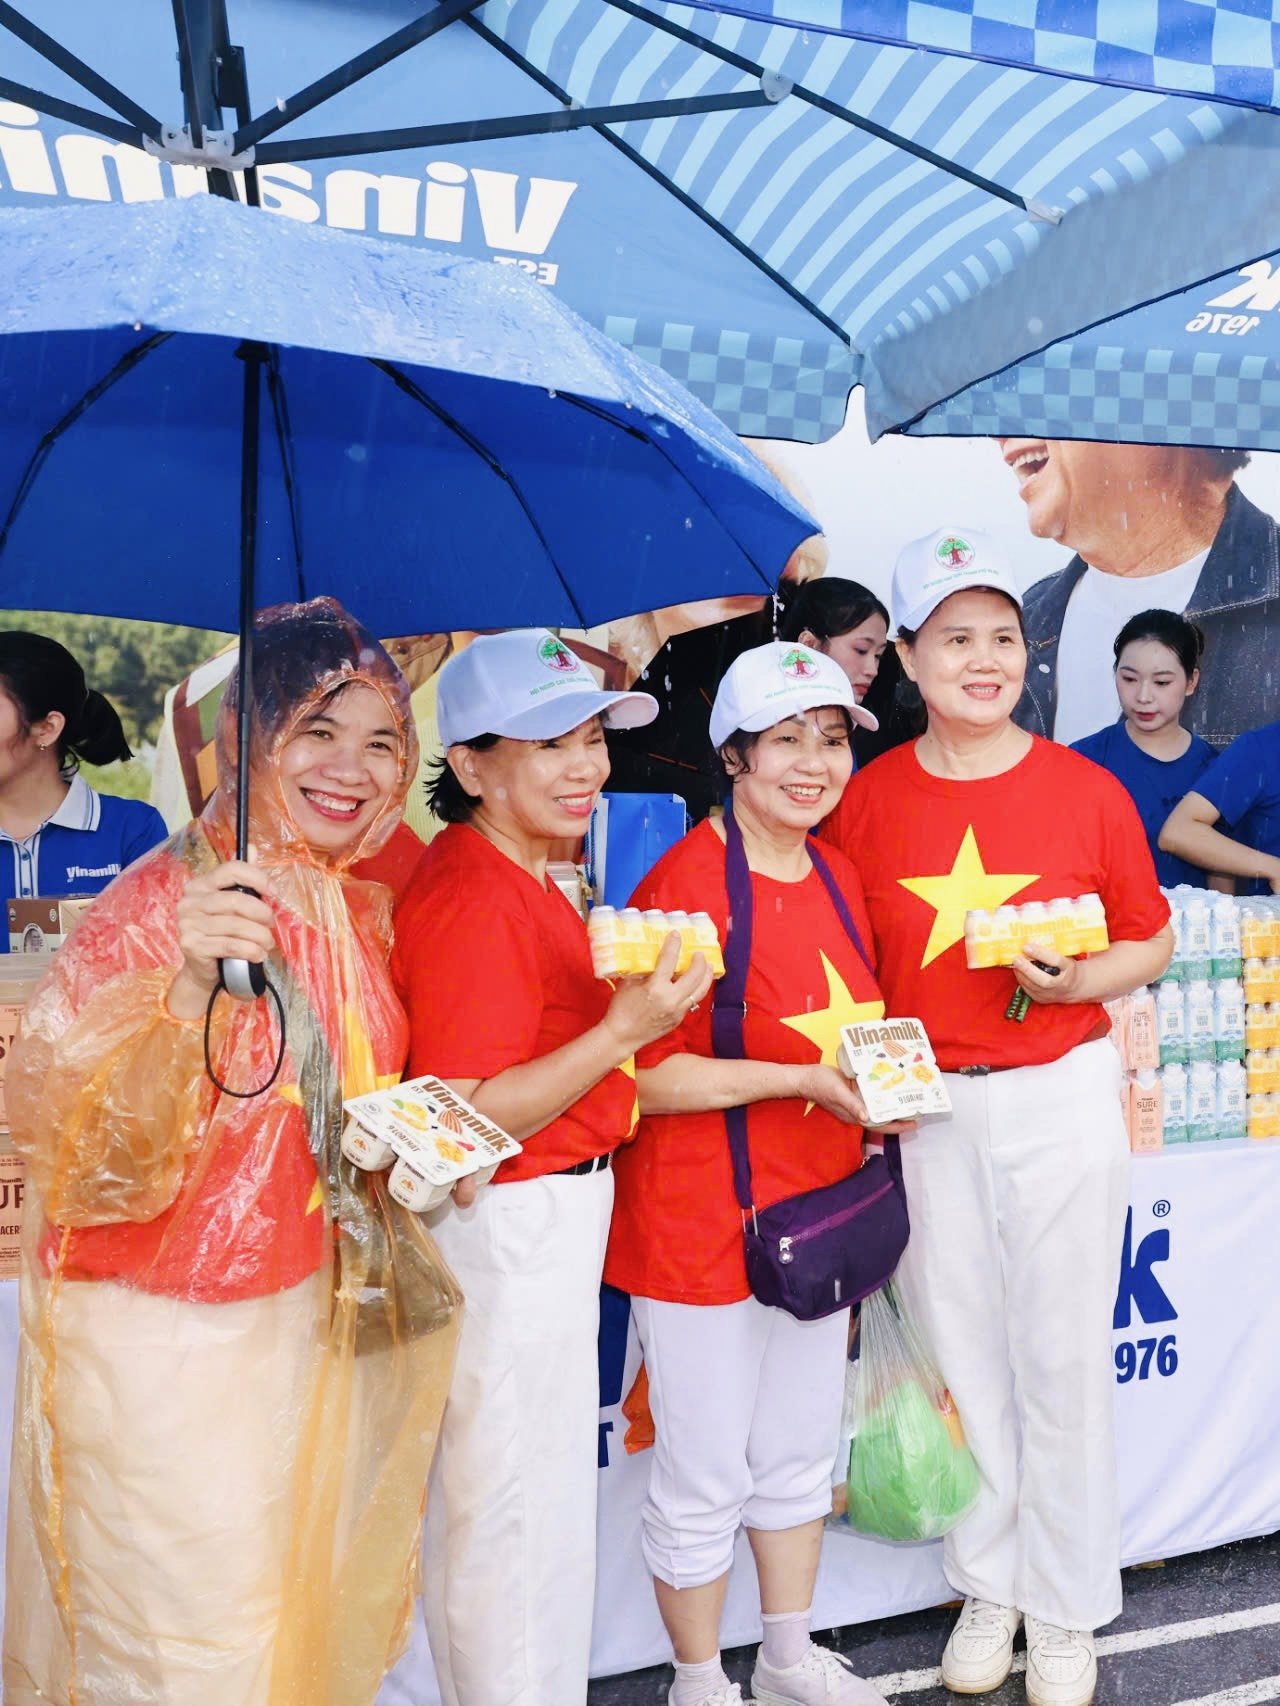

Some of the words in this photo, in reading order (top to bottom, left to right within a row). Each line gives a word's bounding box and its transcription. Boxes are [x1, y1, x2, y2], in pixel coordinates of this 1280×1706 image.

[846, 1022, 923, 1047] Vinamilk
[421, 1080, 512, 1153] Vinamilk
[1112, 1335, 1178, 1384] 976
